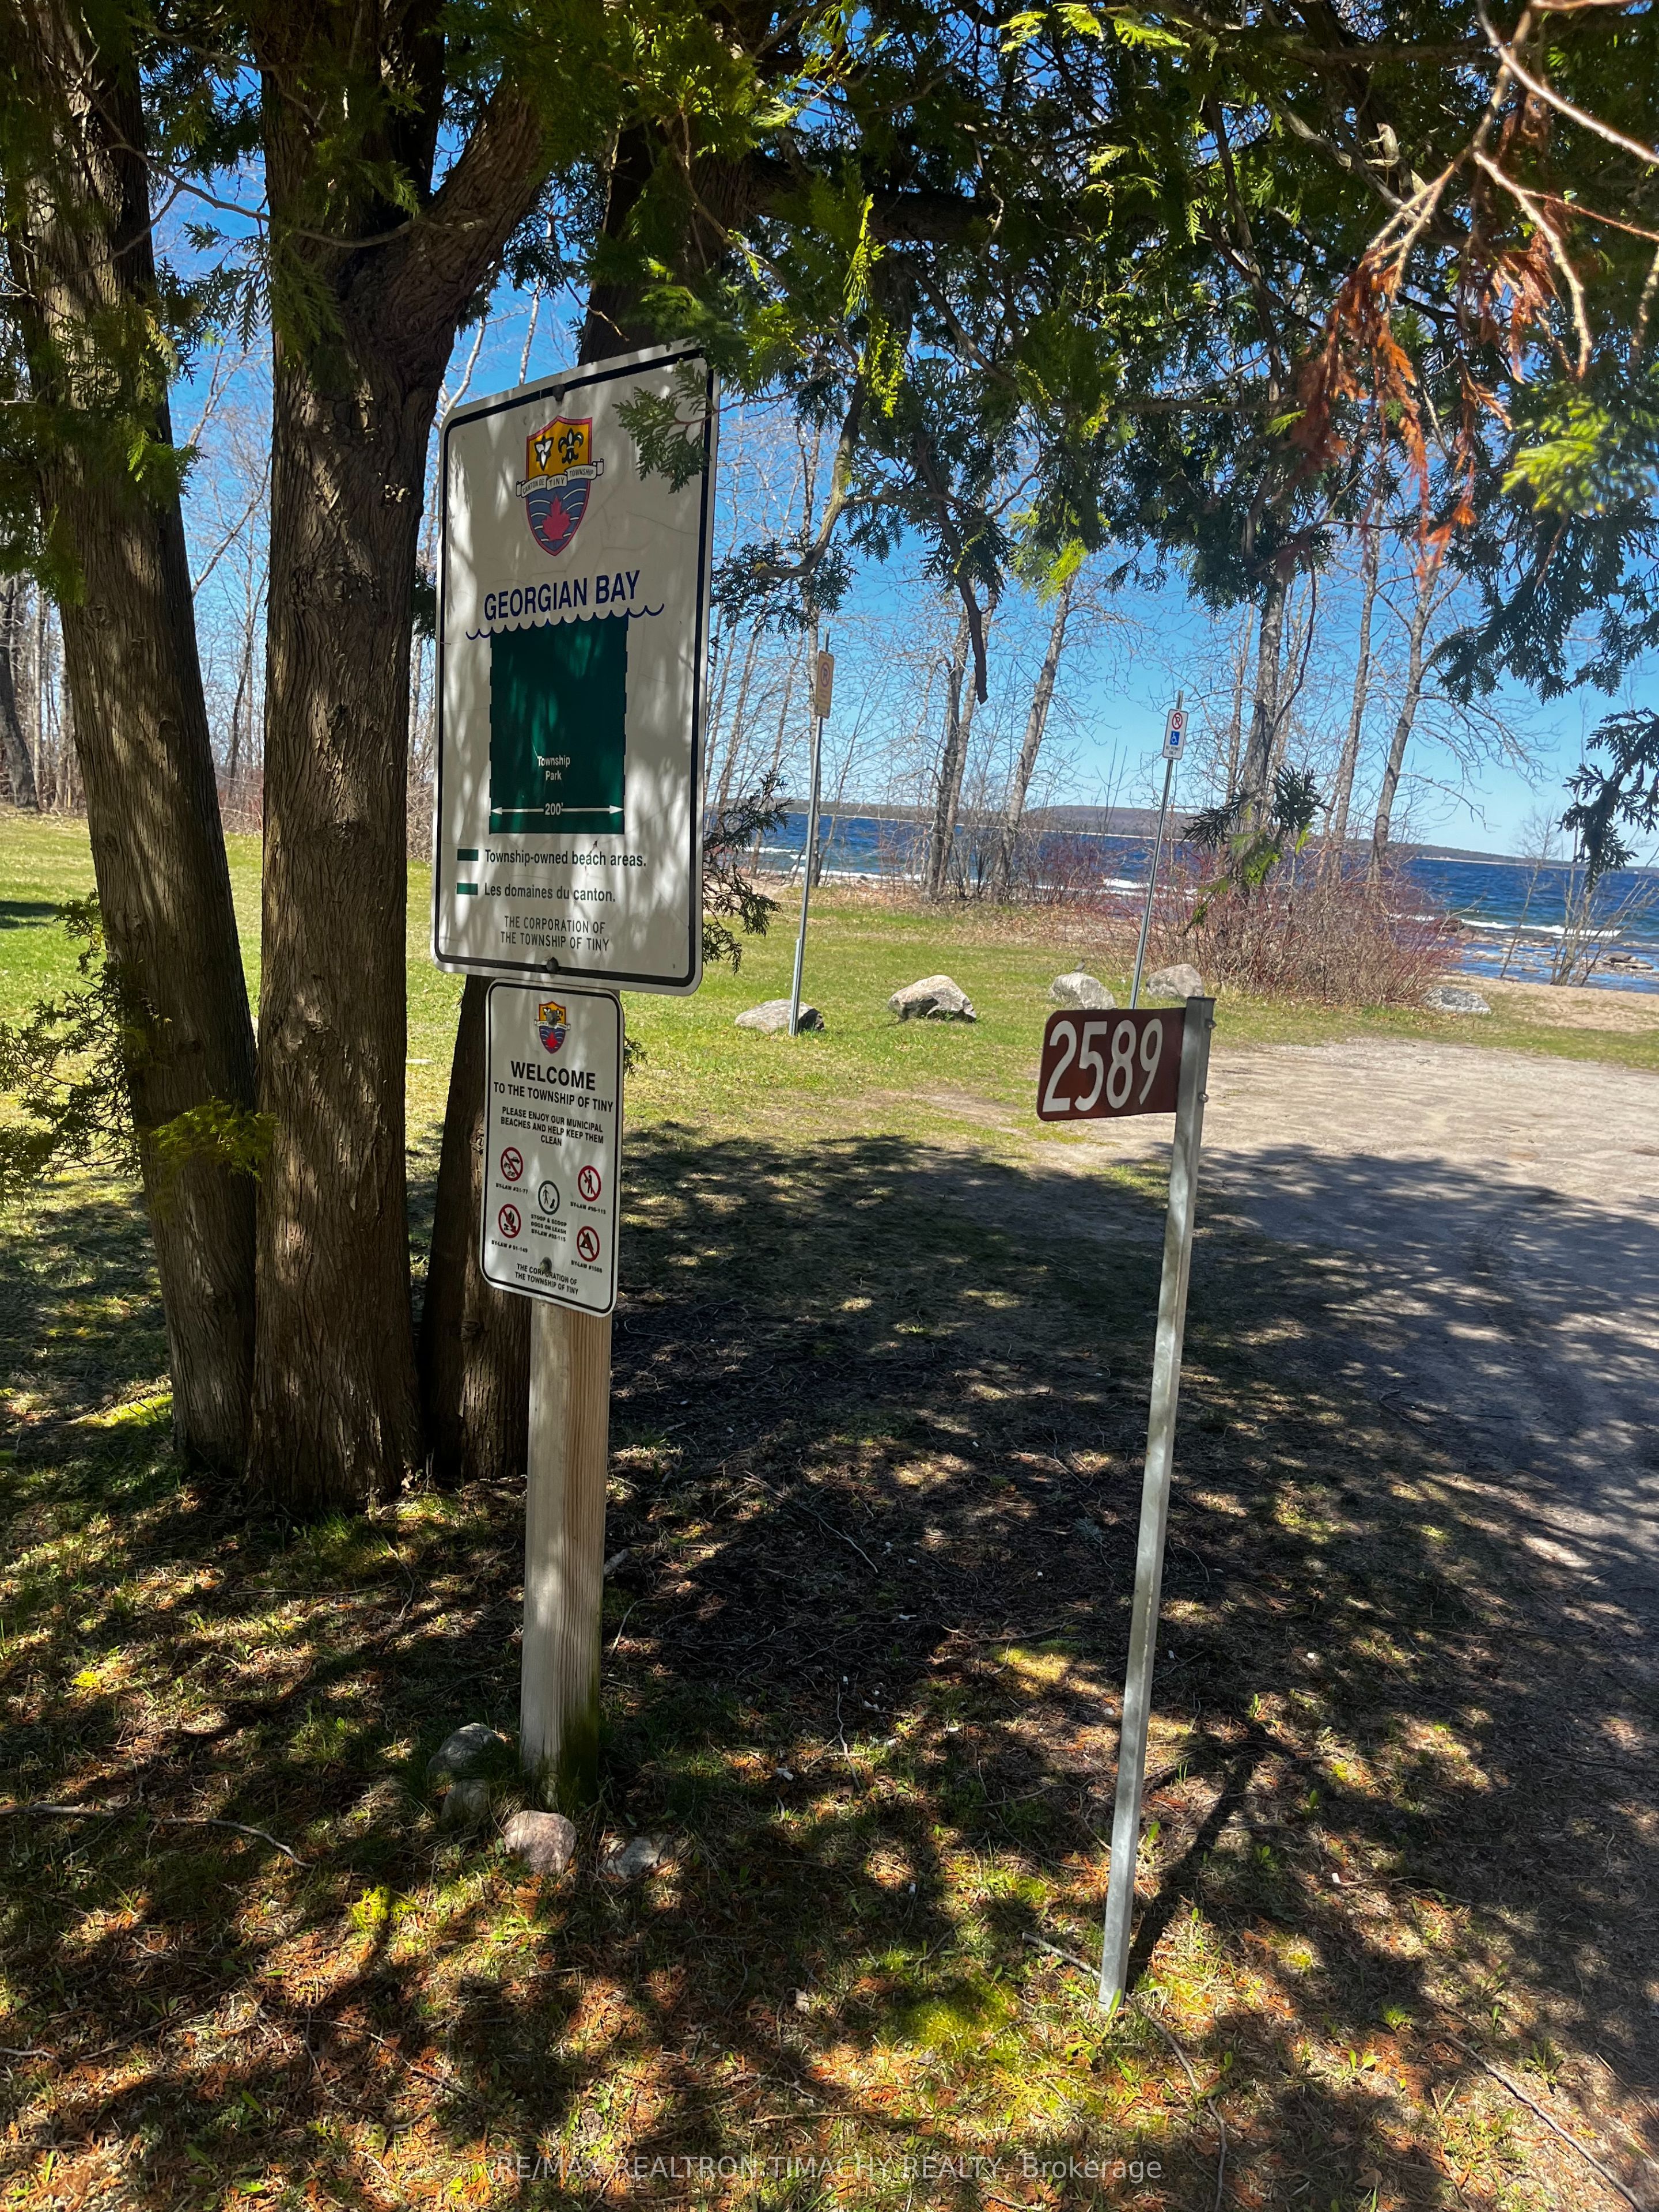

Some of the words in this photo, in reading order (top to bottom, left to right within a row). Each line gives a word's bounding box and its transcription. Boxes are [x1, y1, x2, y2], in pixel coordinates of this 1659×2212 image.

[549, 477, 565, 487] TINY
[570, 468, 594, 478] TOWNSHIP
[522, 480, 538, 494] CANTON
[484, 578, 588, 620] GEORGIAN
[596, 570, 641, 604] BAY
[537, 755, 570, 767] Township
[546, 770, 562, 781] Park
[485, 849, 568, 865] Township-owned
[572, 852, 606, 865] beach
[611, 855, 646, 867] areas.
[484, 884, 501, 896] Les
[505, 883, 553, 899] domaines
[556, 886, 570, 900] du
[574, 889, 616, 903] canton.
[504, 916, 520, 929] THE
[524, 917, 589, 933] CORPORATION
[593, 922, 605, 934] OF
[501, 931, 517, 944] THE
[520, 933, 566, 948] TOWNSHIP
[570, 937, 582, 949] OF
[586, 938, 609, 952] TINY
[1042, 1018, 1163, 1112] 2589
[510, 1060, 596, 1090] WELCOME
[494, 1081, 505, 1093] TO
[508, 1084, 525, 1097] THE
[528, 1087, 575, 1105] TOWNSHIP
[578, 1096, 590, 1108] OF
[592, 1099, 613, 1112] TINY
[502, 1106, 527, 1118] PLEASE
[528, 1111, 549, 1122] ENJOY
[551, 1115, 565, 1125] OUR
[567, 1118, 603, 1132] MUNICIPAL
[501, 1116, 531, 1129] BEACHES
[532, 1123, 546, 1132] AND
[548, 1126, 564, 1135] HELP
[566, 1129, 583, 1139] KEEP
[585, 1132, 604, 1143] THEM
[541, 1134, 562, 1146] CLEAN
[531, 1229, 548, 1237] BY-LAW
[491, 1240, 507, 1248] BY-LAW
[517, 1263, 528, 1272] THE
[529, 1266, 569, 1283] CORPORATION
[515, 1271, 526, 1280] THE
[527, 1274, 556, 1287] TOWNSHIP
[566, 1285, 578, 1295] TINY
